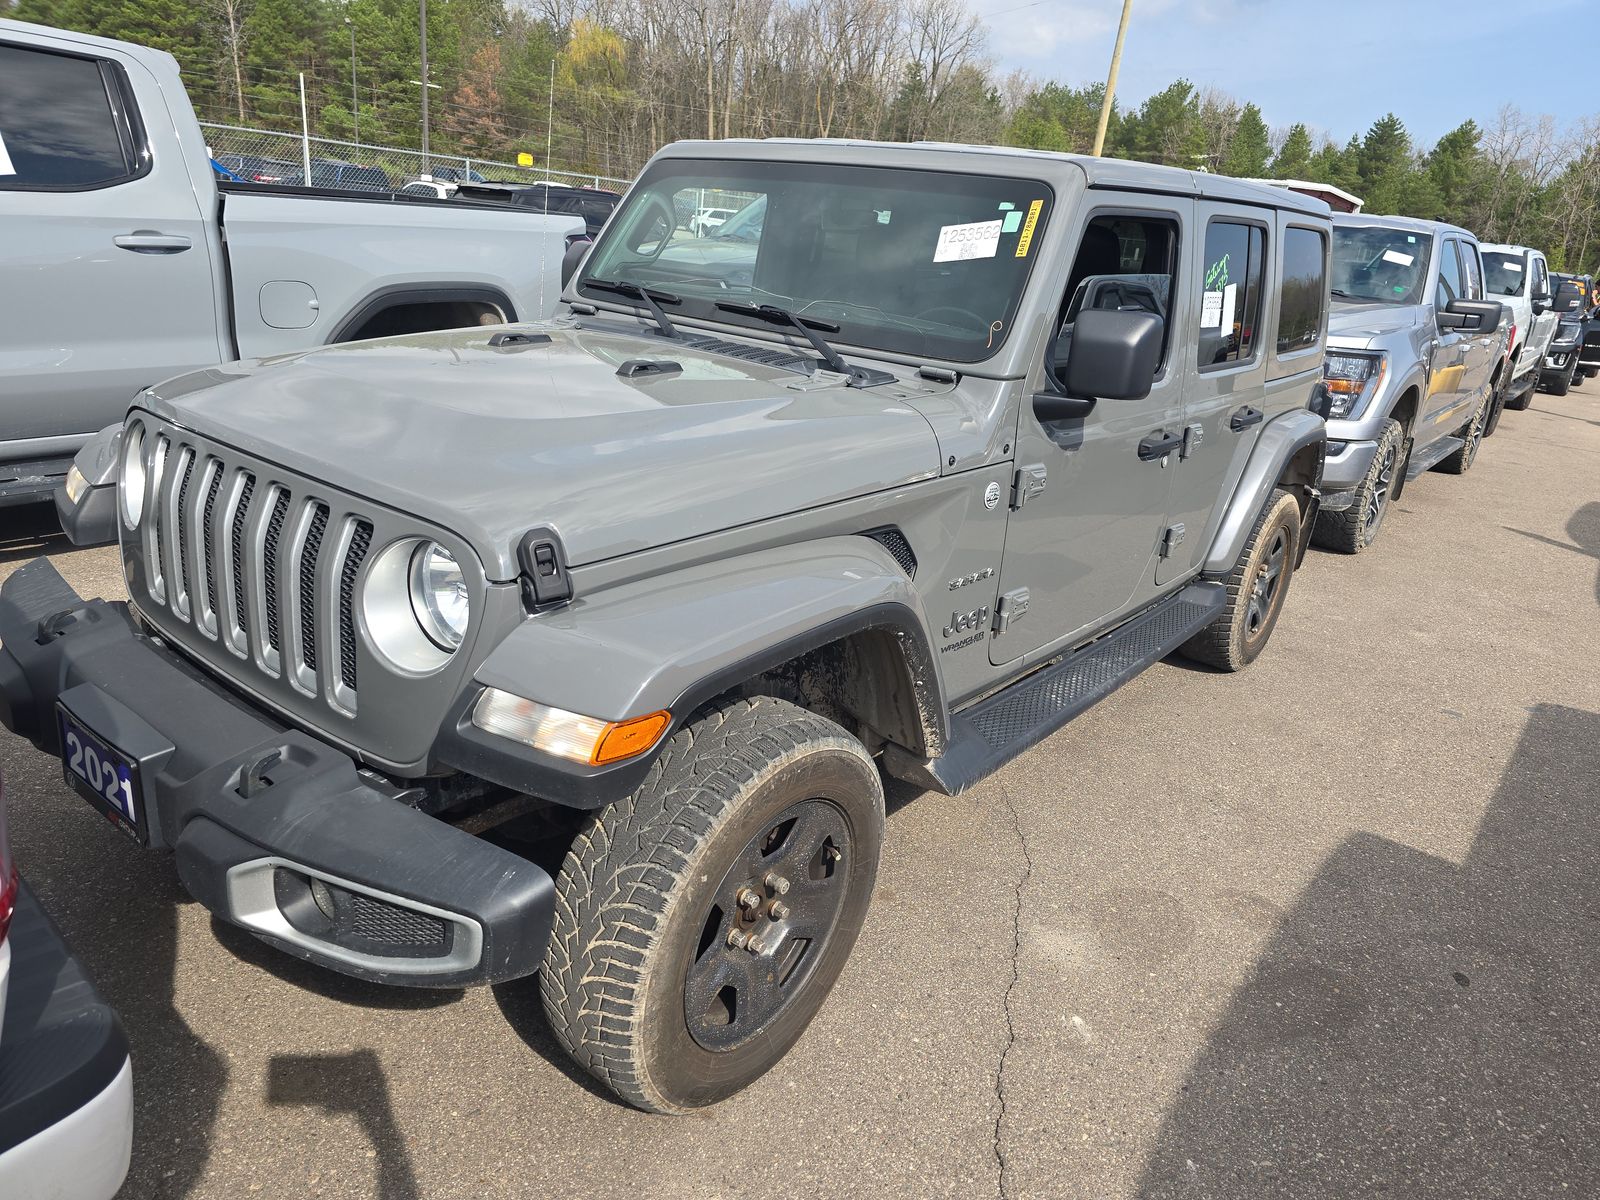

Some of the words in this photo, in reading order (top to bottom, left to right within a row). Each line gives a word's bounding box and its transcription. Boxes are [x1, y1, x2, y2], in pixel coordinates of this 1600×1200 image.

[943, 224, 1001, 244] 1253562
[943, 605, 990, 638] Jeep
[940, 631, 985, 654] WRANGLER
[66, 731, 136, 823] 2021
